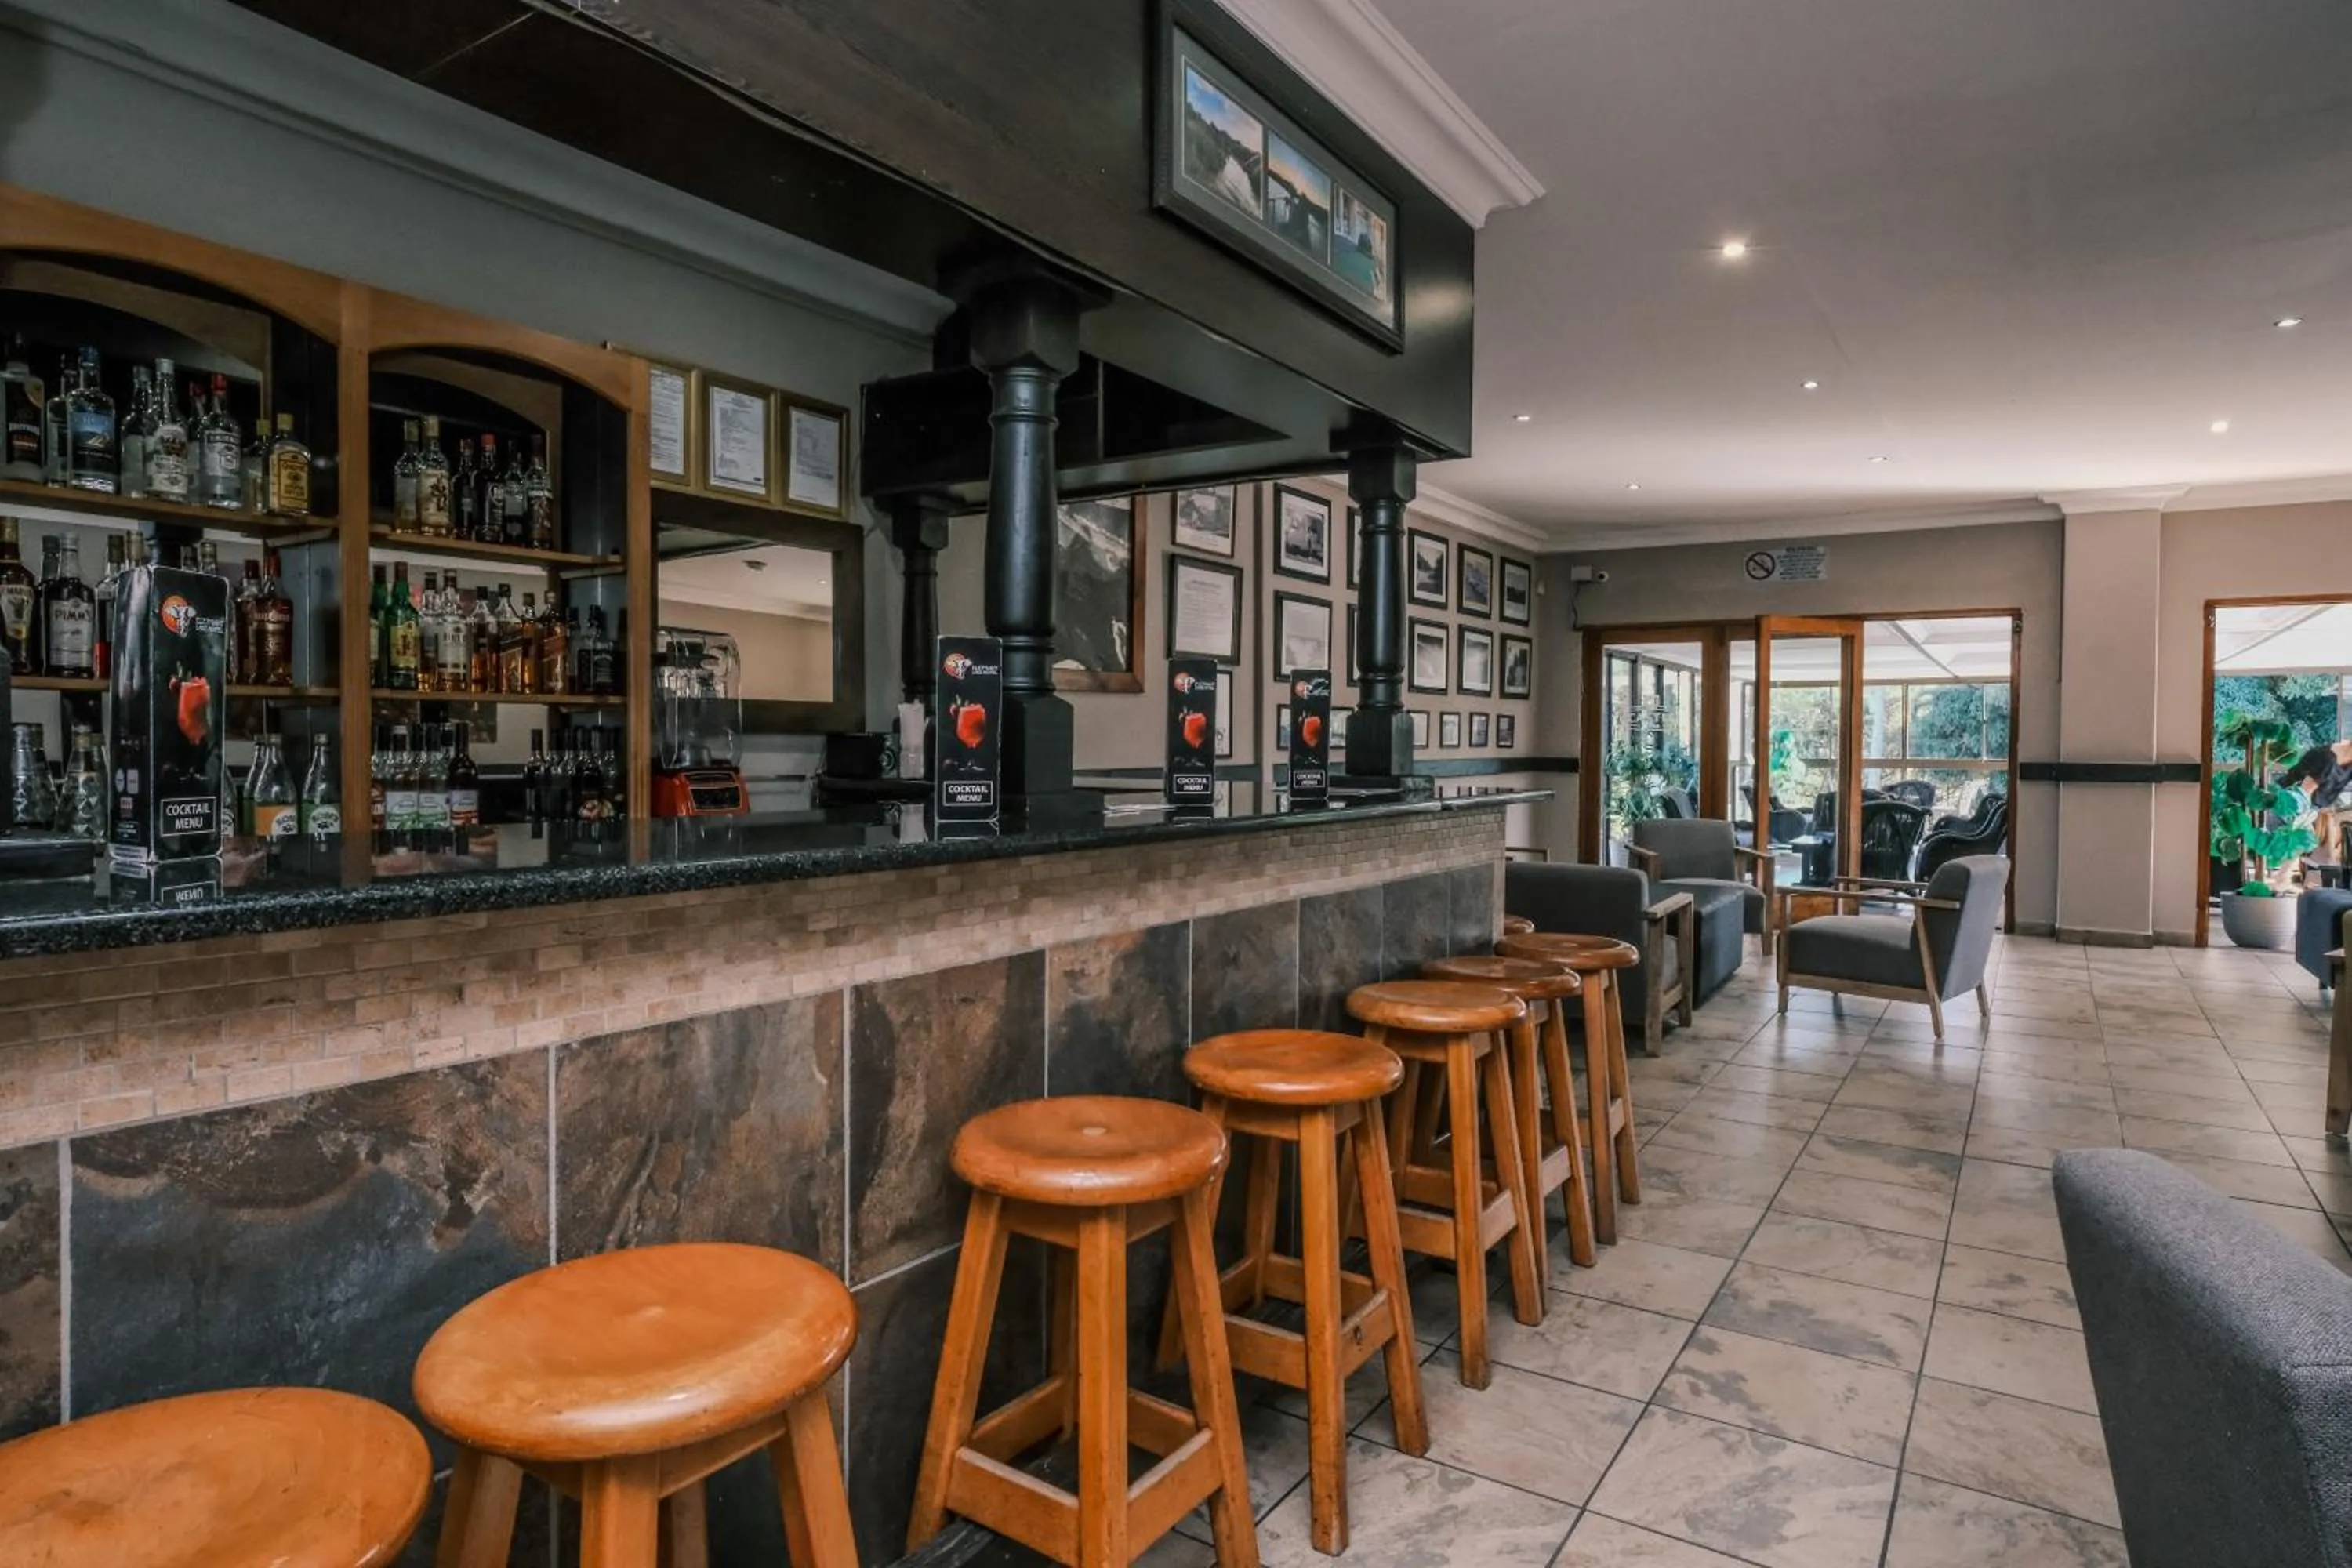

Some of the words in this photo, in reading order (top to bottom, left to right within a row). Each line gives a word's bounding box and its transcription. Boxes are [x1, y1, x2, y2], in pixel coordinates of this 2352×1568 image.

[948, 785, 989, 793] COCKTAIL
[956, 793, 983, 802] MENU
[165, 802, 212, 816] COCKTAIL
[175, 817, 203, 830] MENU
